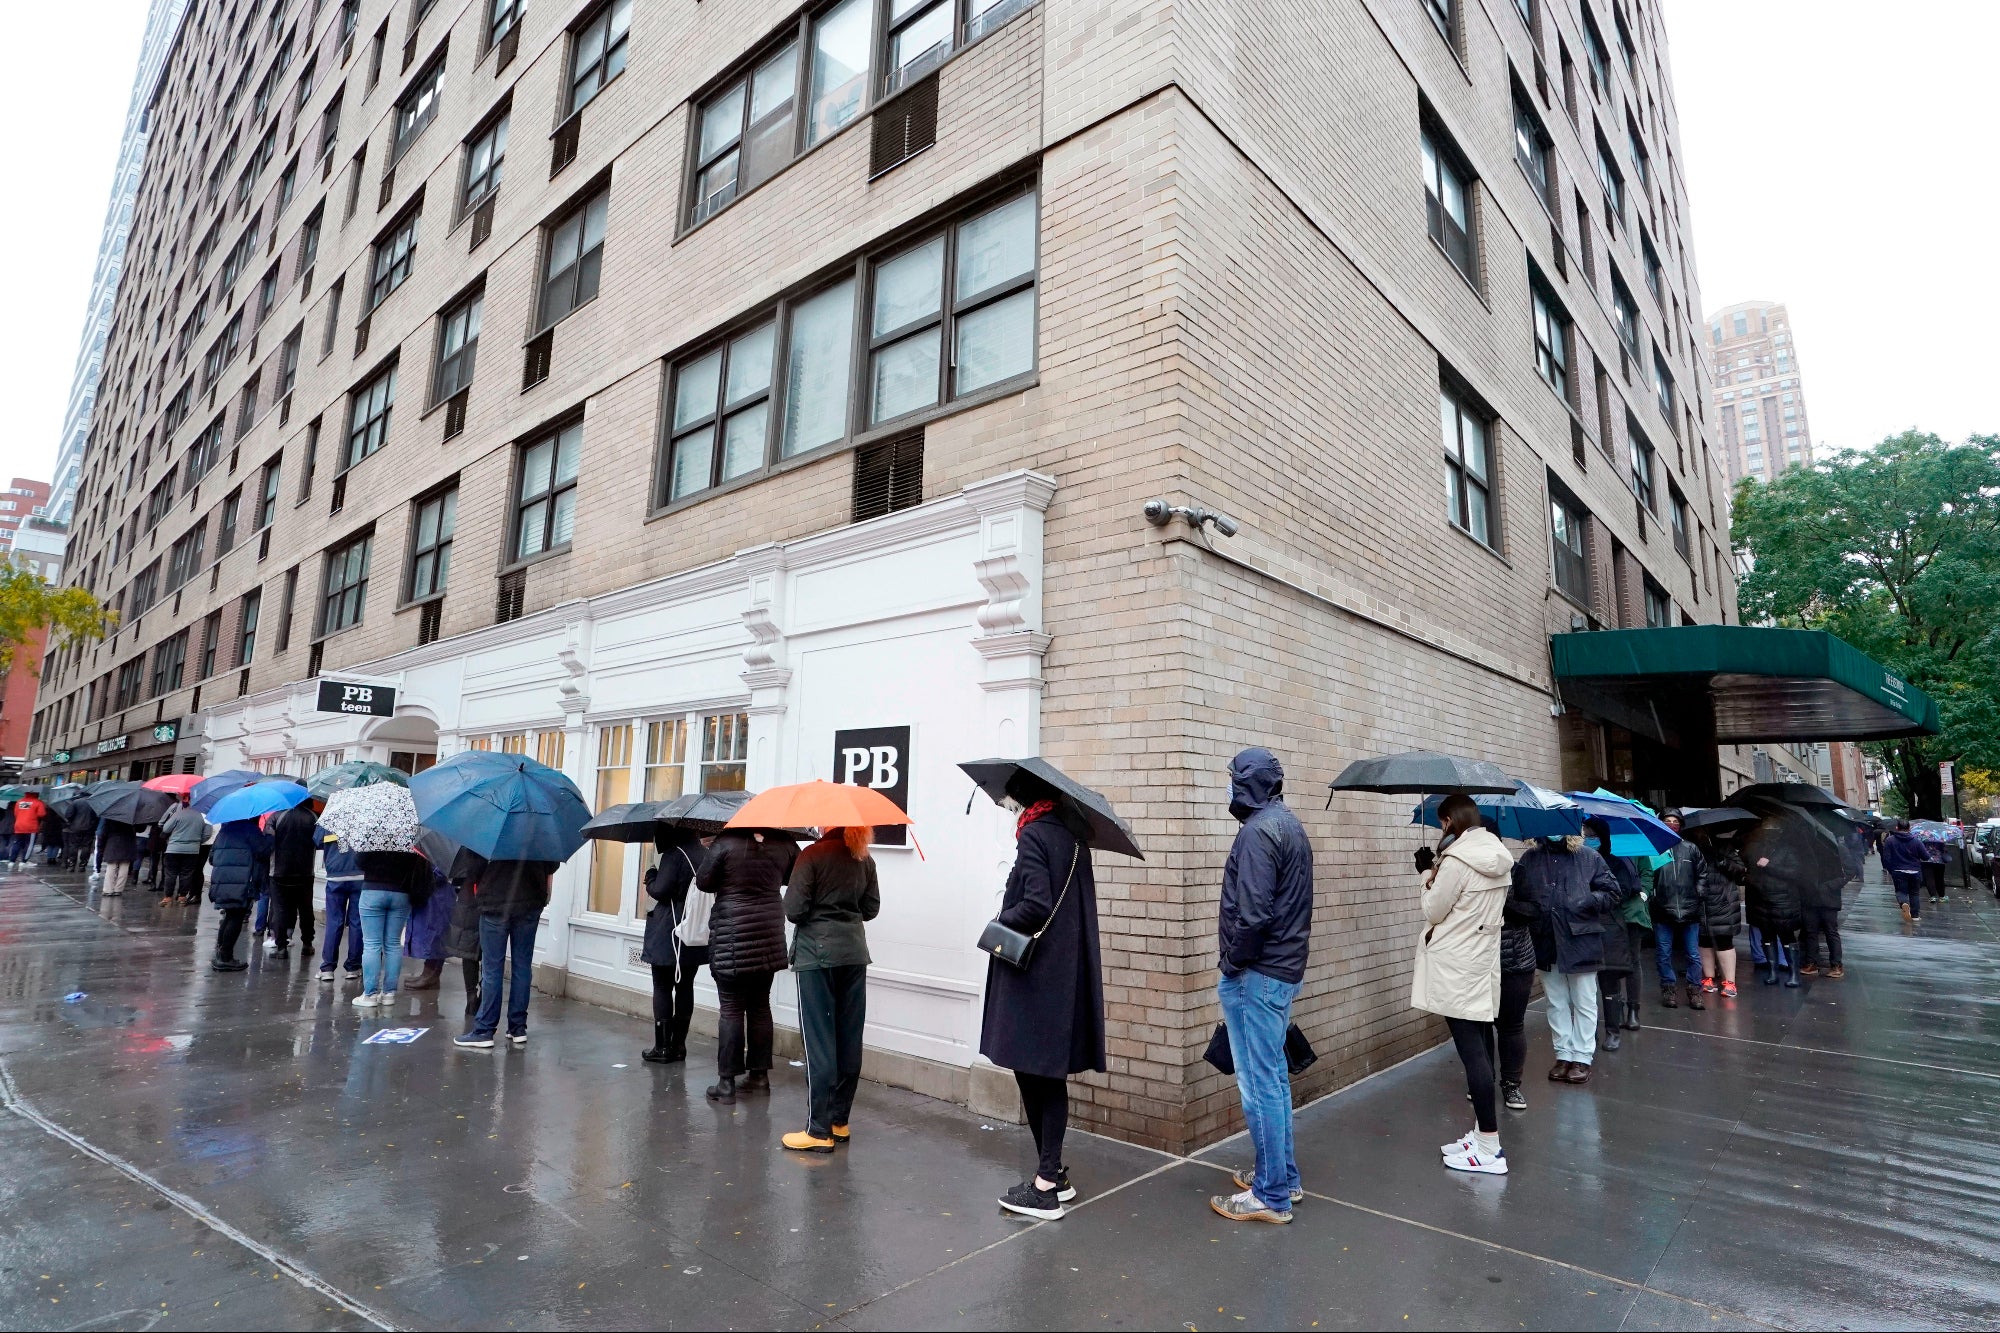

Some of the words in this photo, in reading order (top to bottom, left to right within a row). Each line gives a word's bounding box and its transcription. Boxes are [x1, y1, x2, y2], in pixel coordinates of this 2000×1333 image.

[342, 686, 372, 702] PB
[341, 702, 371, 713] teen
[841, 746, 899, 789] PB
